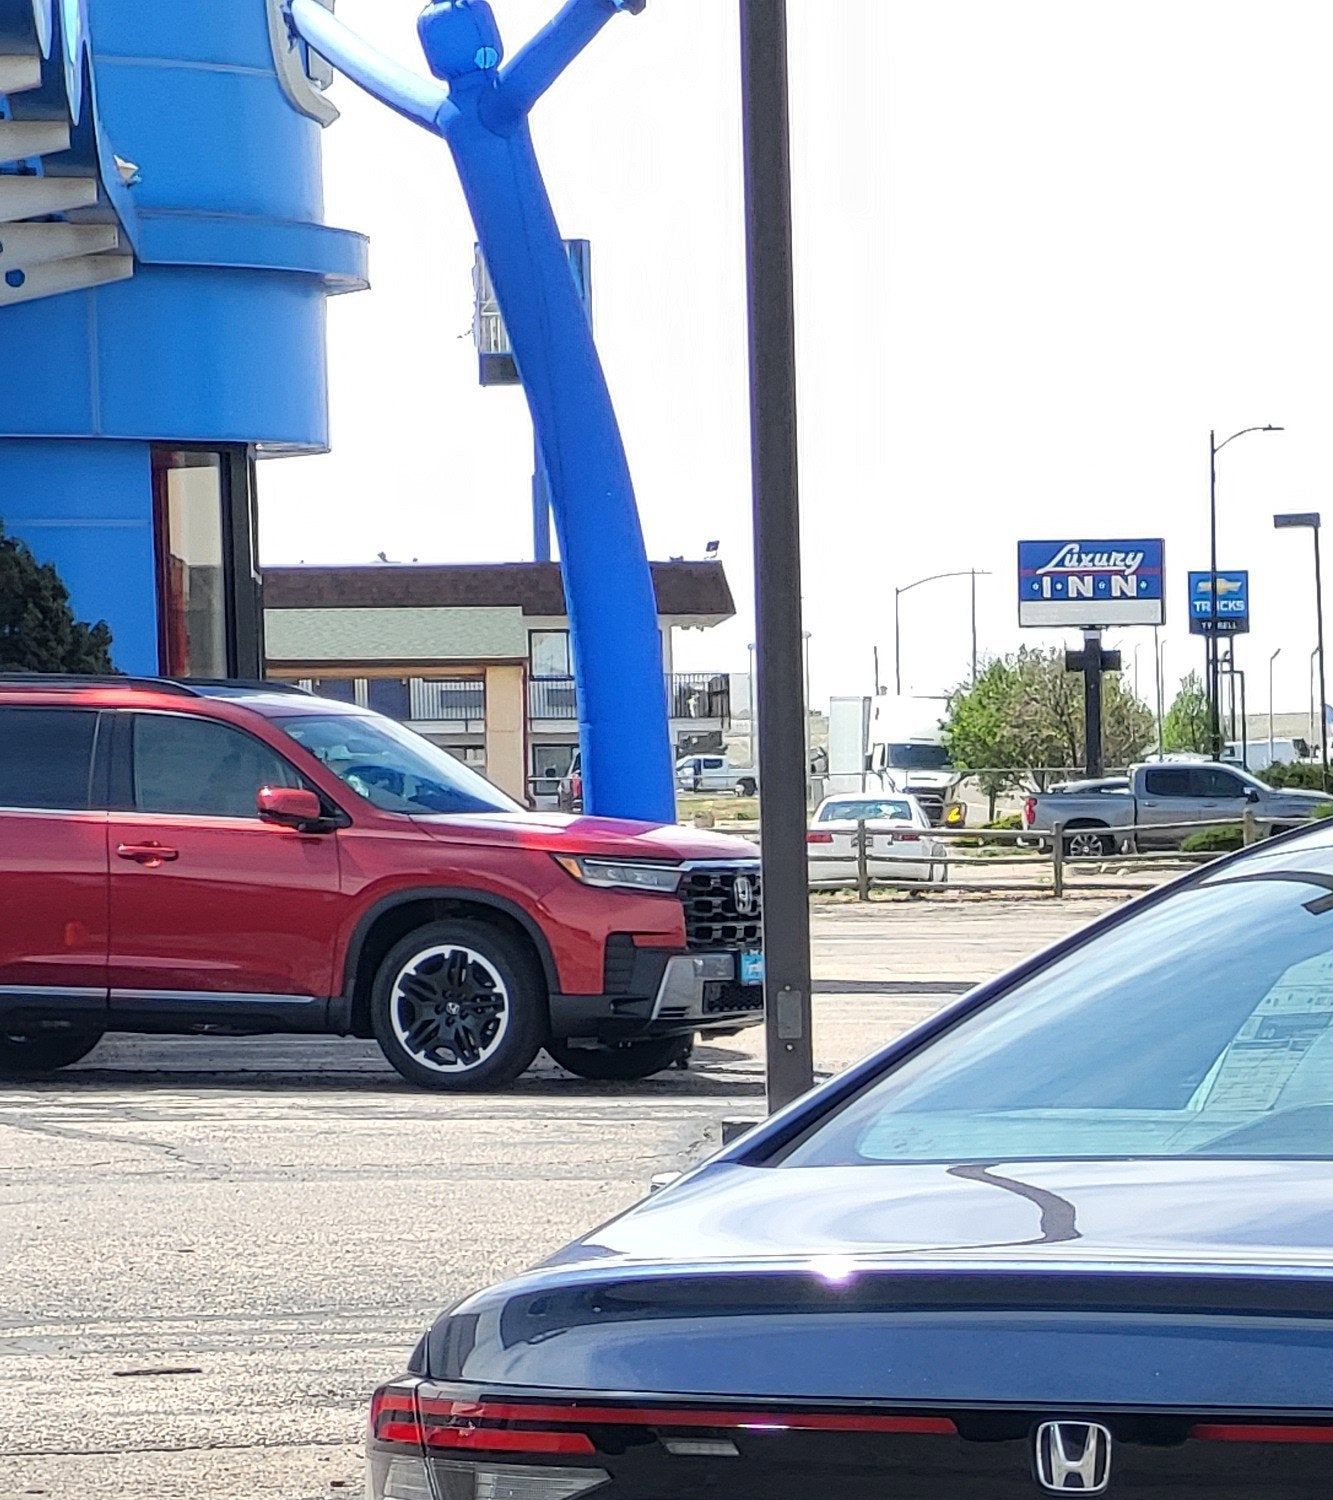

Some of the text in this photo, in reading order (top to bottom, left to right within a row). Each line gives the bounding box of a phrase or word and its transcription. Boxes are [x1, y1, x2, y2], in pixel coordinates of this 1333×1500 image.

[1036, 543, 1144, 575] Luxury
[1042, 575, 1138, 598] INN
[1202, 621, 1237, 630] TYRELL
